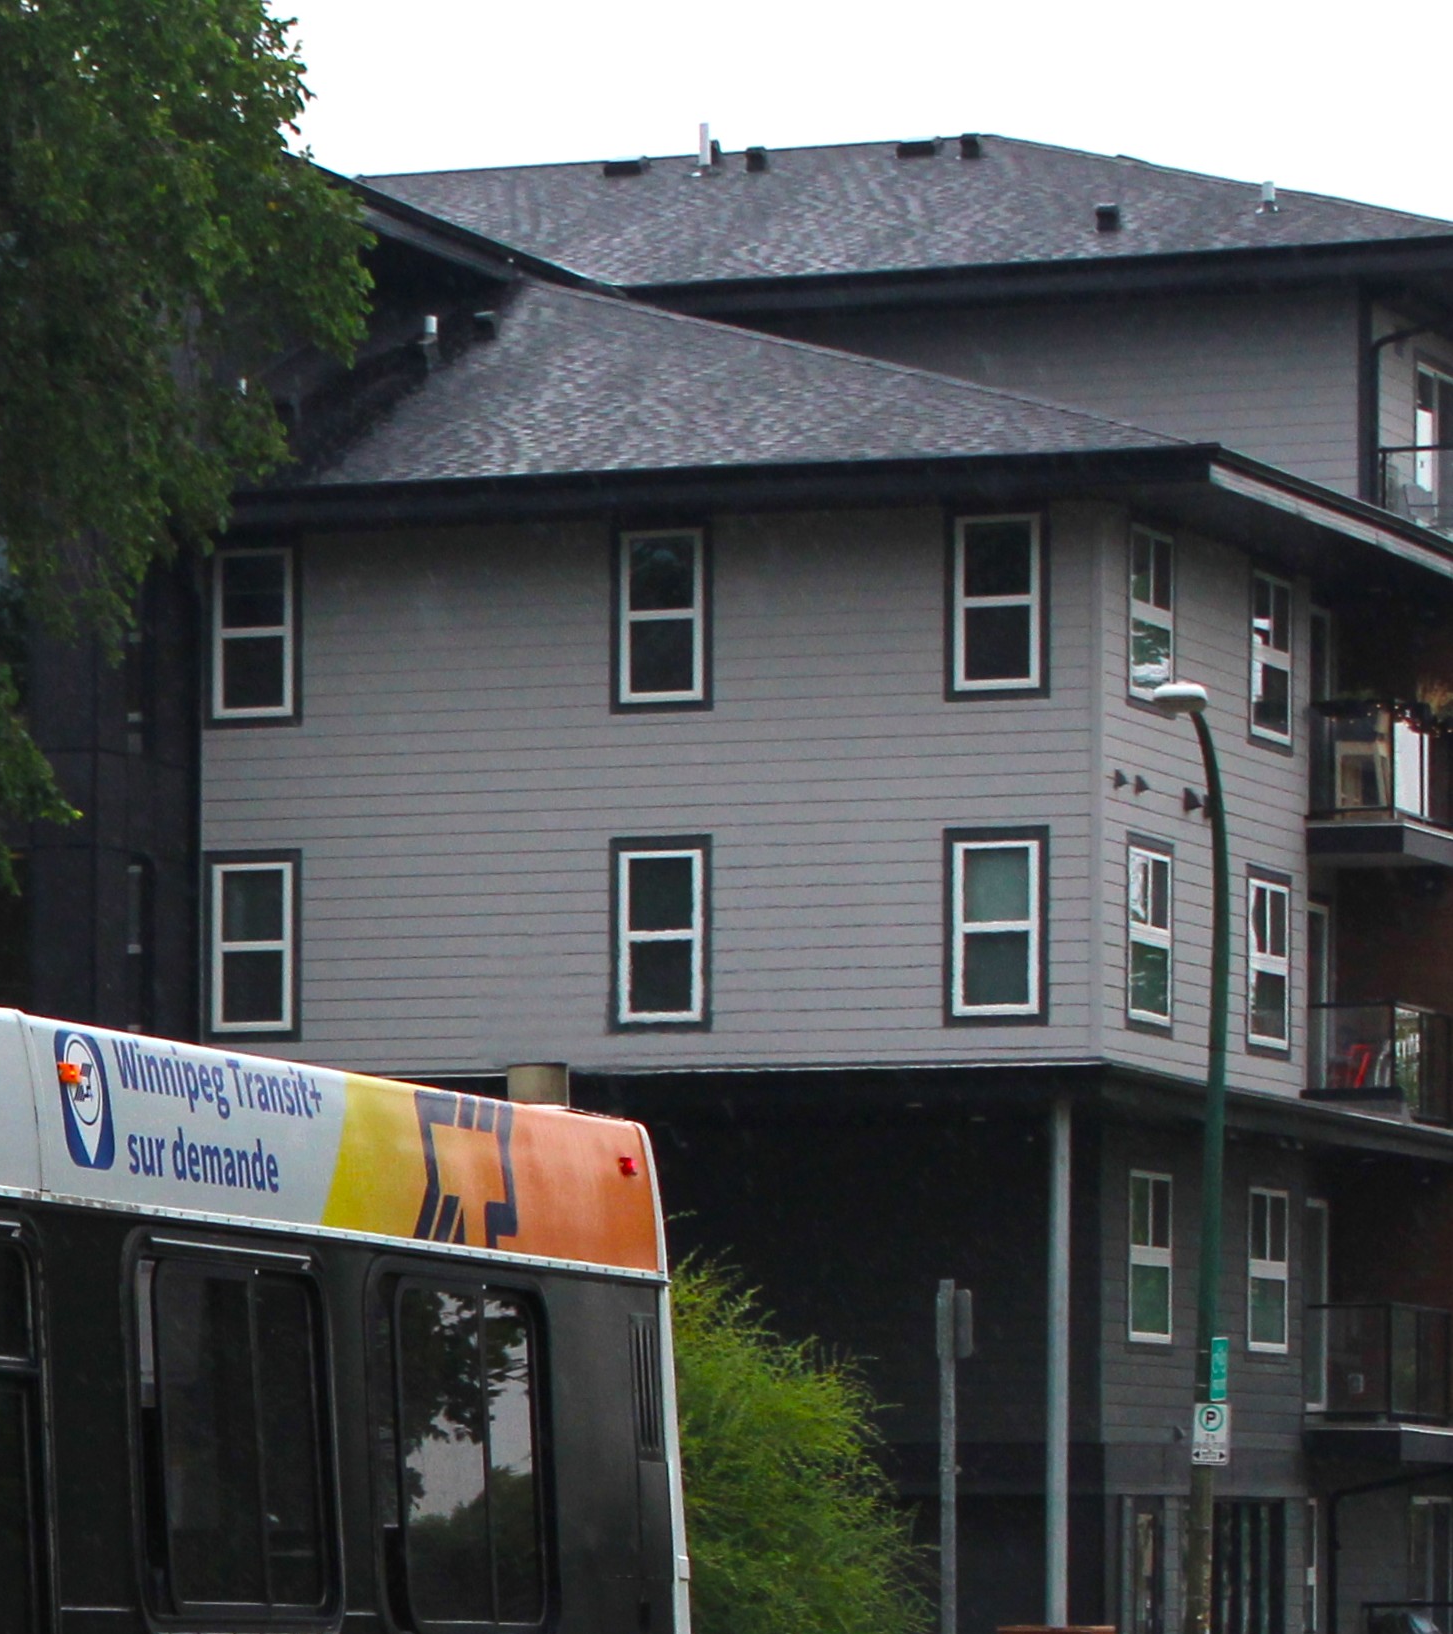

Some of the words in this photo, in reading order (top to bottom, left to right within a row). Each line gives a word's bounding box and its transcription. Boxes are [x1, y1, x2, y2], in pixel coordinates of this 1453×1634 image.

[111, 1038, 231, 1120] Winnipeg
[226, 1058, 323, 1119] Transit+
[127, 1133, 166, 1177] sur
[172, 1126, 280, 1193] demande
